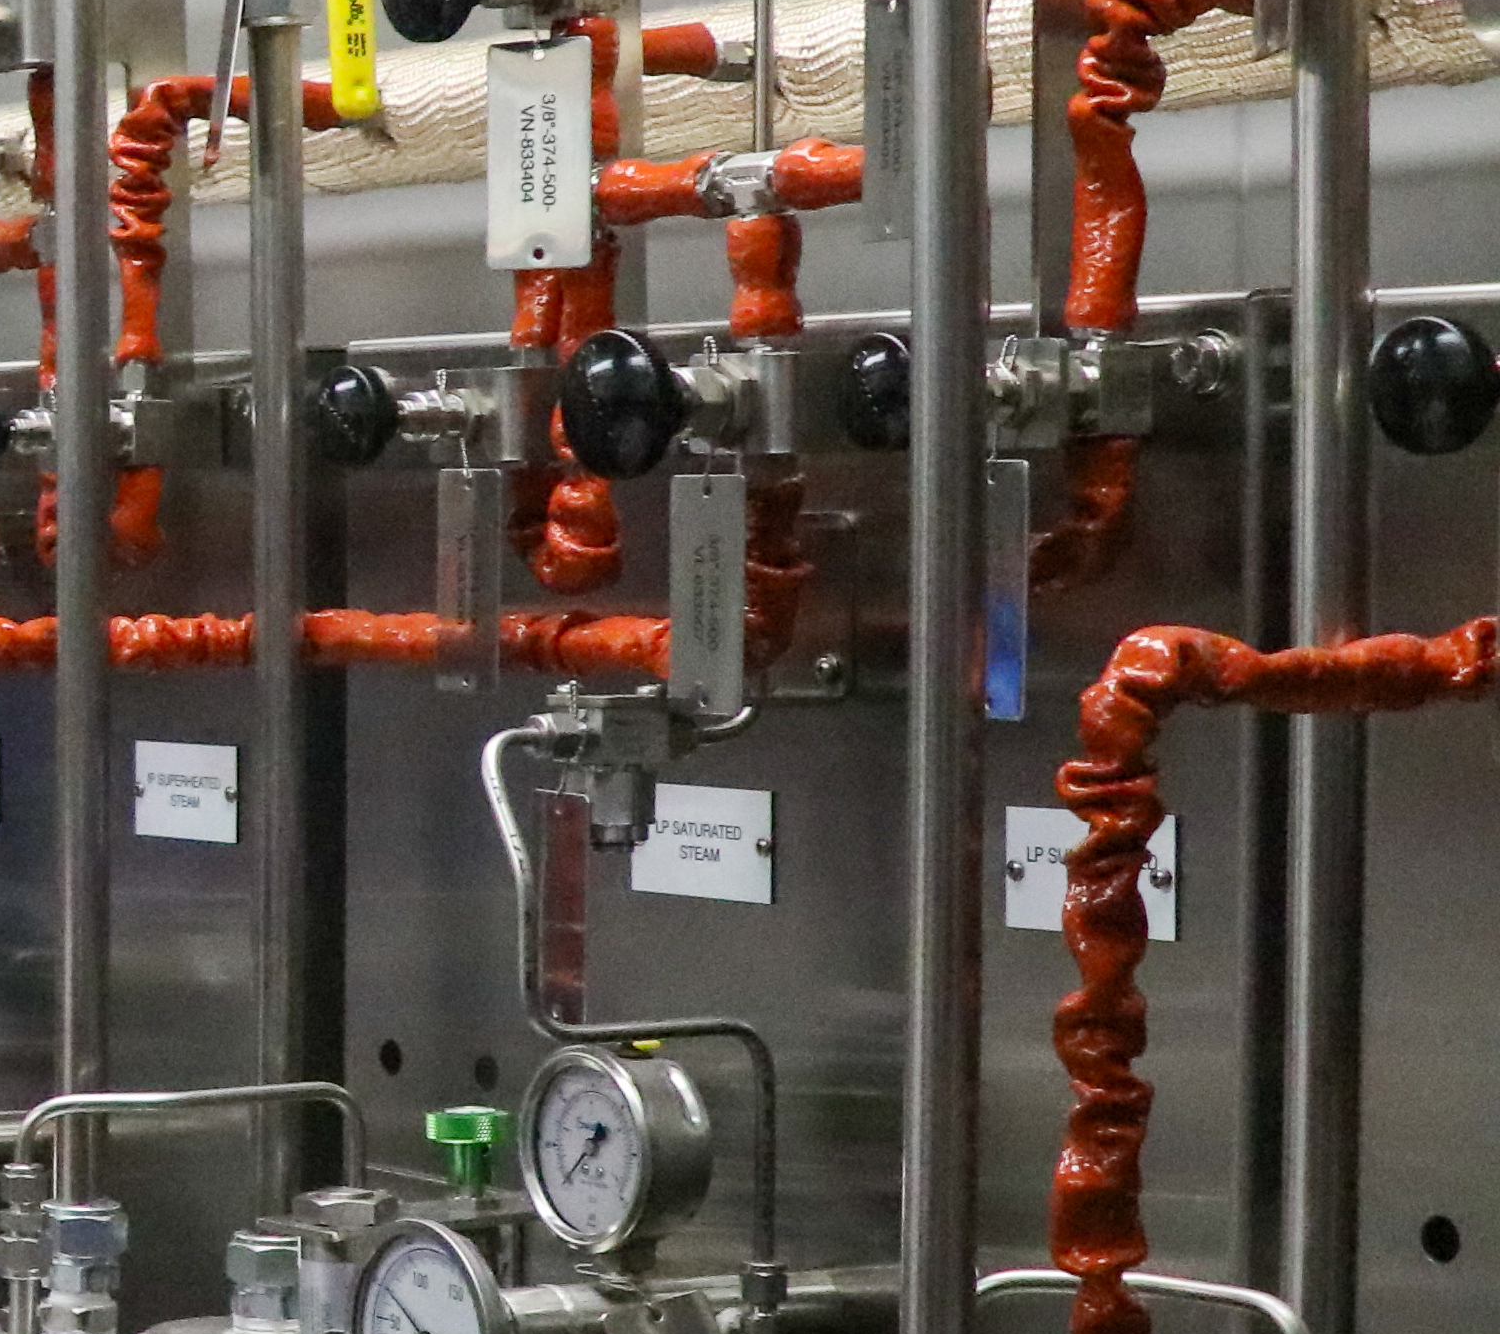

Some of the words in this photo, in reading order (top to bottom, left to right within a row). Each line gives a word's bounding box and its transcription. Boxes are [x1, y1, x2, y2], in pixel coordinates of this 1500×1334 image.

[520, 105, 536, 203] VN-833404
[157, 774, 221, 791] SUPERHEATED
[170, 794, 201, 809] STEAM
[655, 820, 670, 834] LP
[672, 820, 743, 841] SATURATED
[679, 845, 721, 862] STEAM
[1026, 845, 1044, 863] LP
[413, 1271, 429, 1290] 100
[448, 1283, 465, 1302] 150
